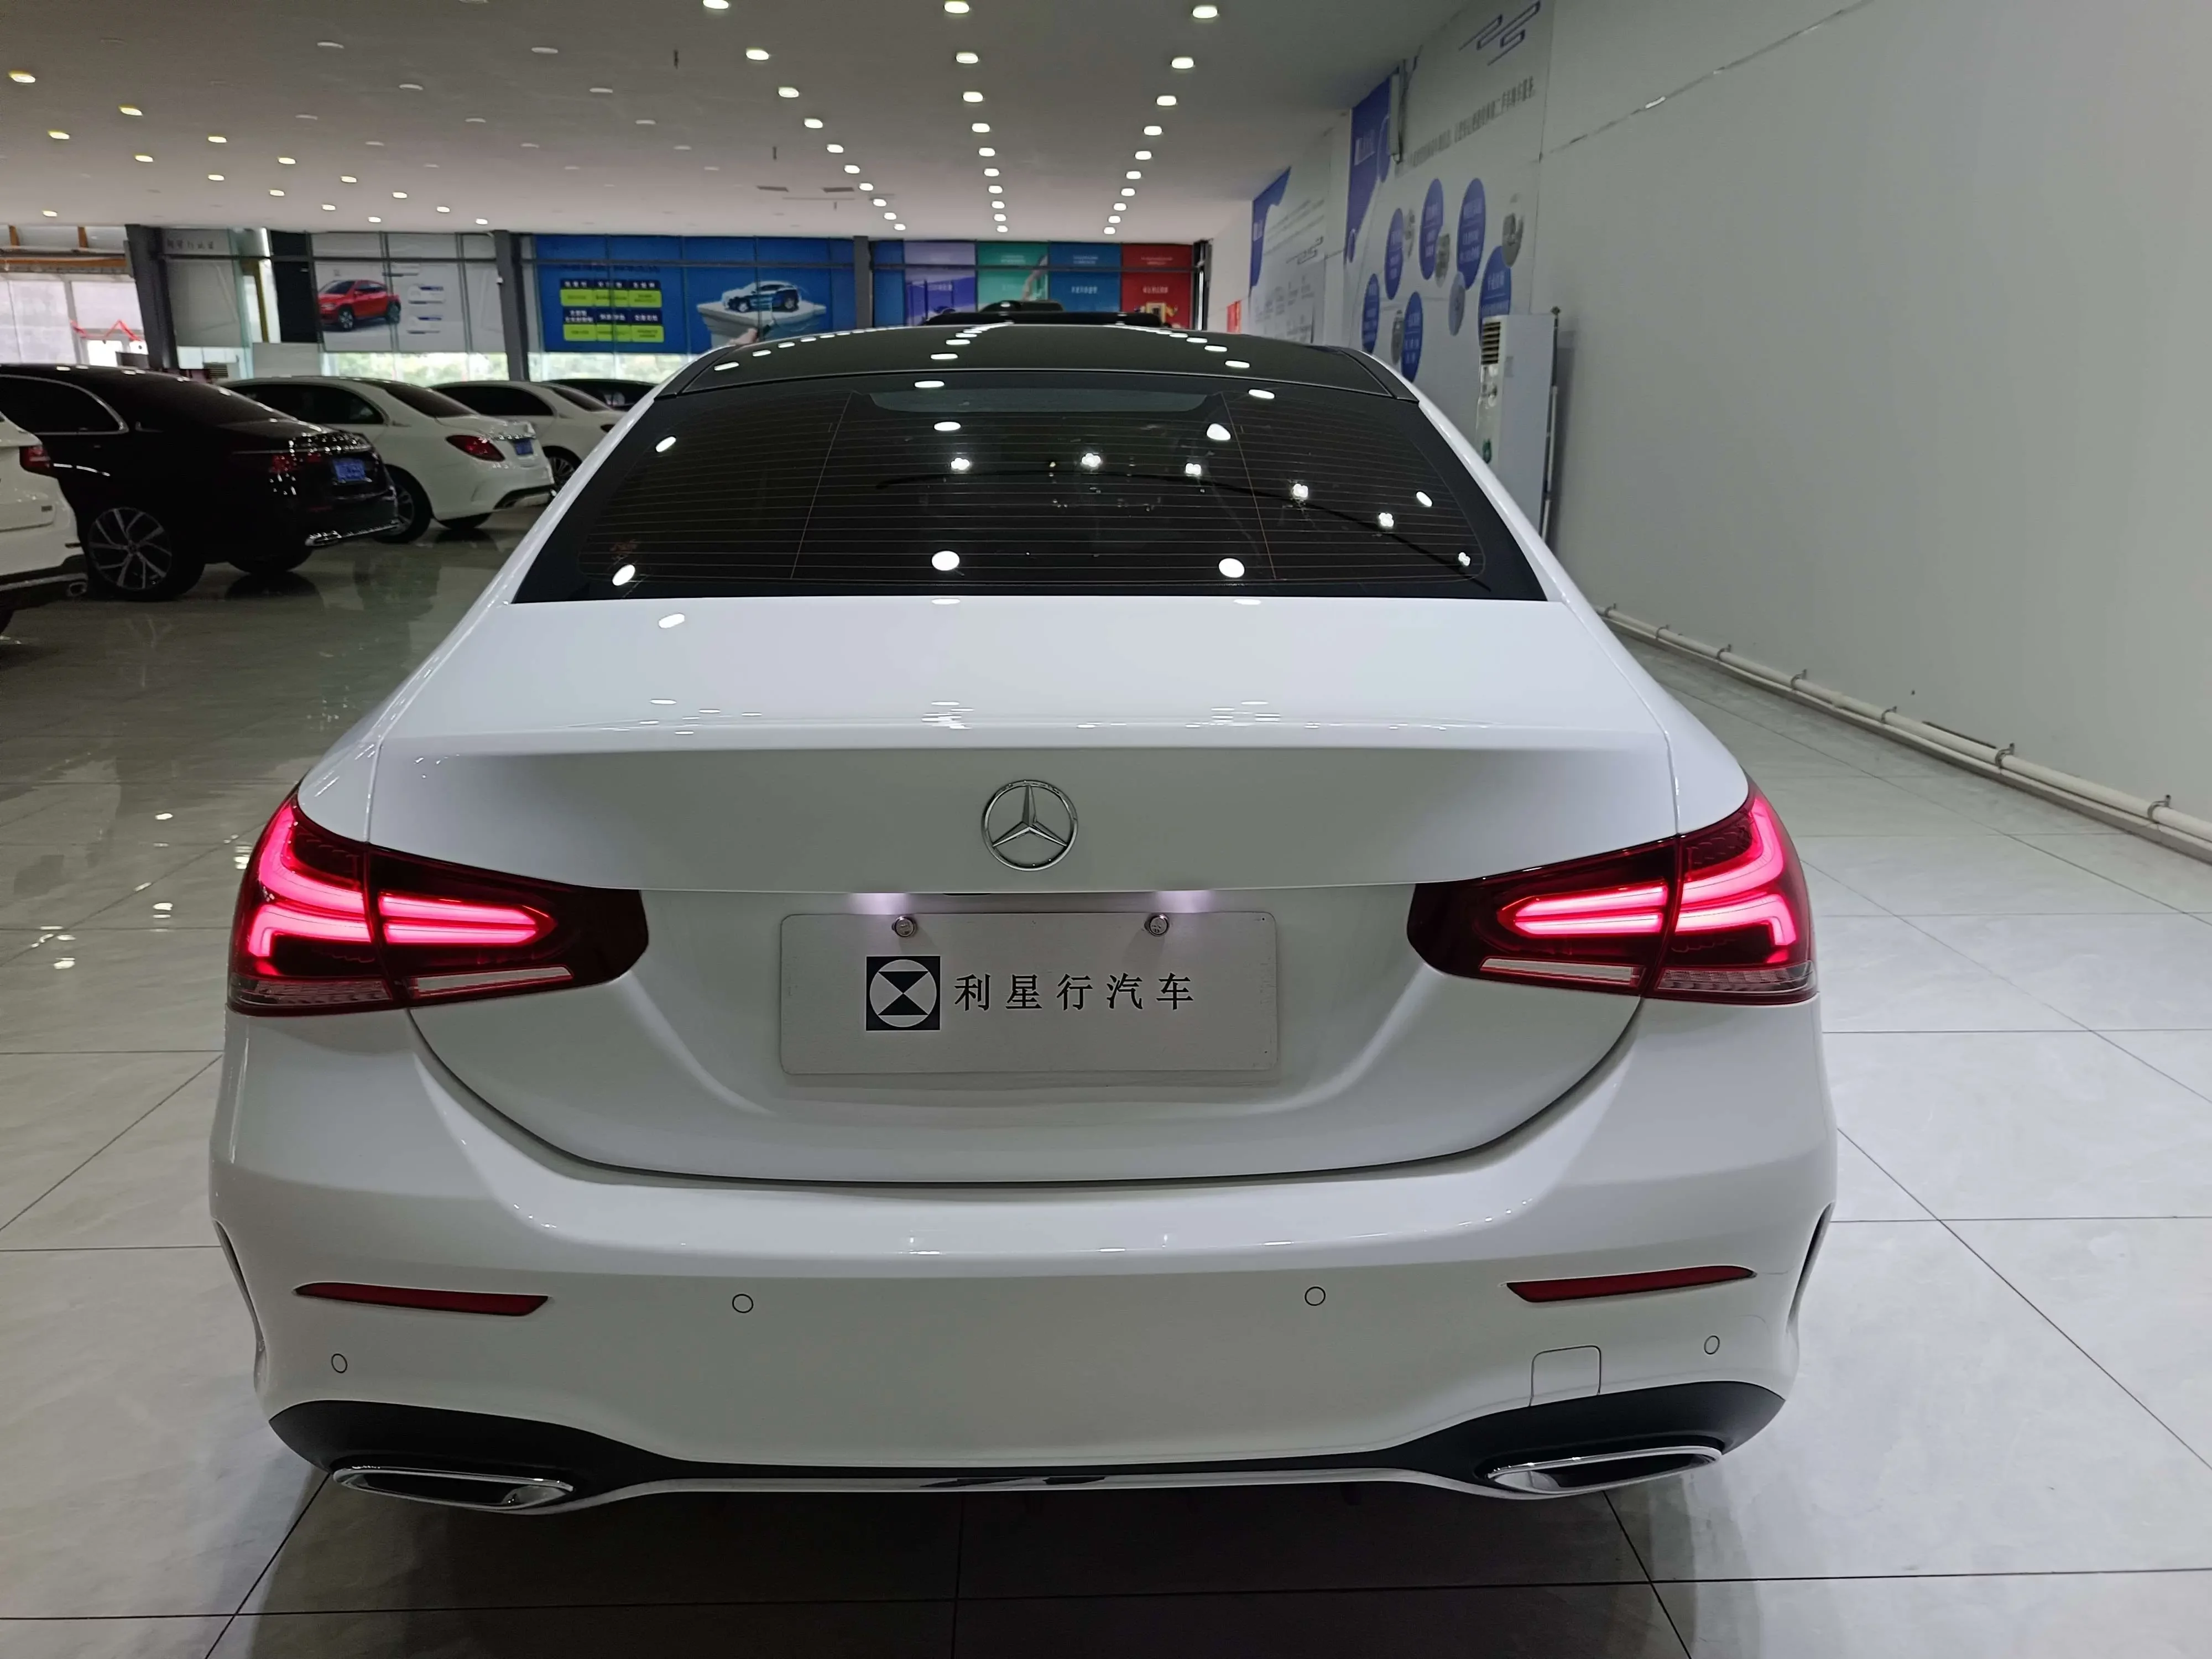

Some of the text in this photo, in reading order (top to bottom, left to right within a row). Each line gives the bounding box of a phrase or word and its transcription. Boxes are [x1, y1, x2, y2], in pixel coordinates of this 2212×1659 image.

[954, 972, 1194, 1011] 利星行汽车
